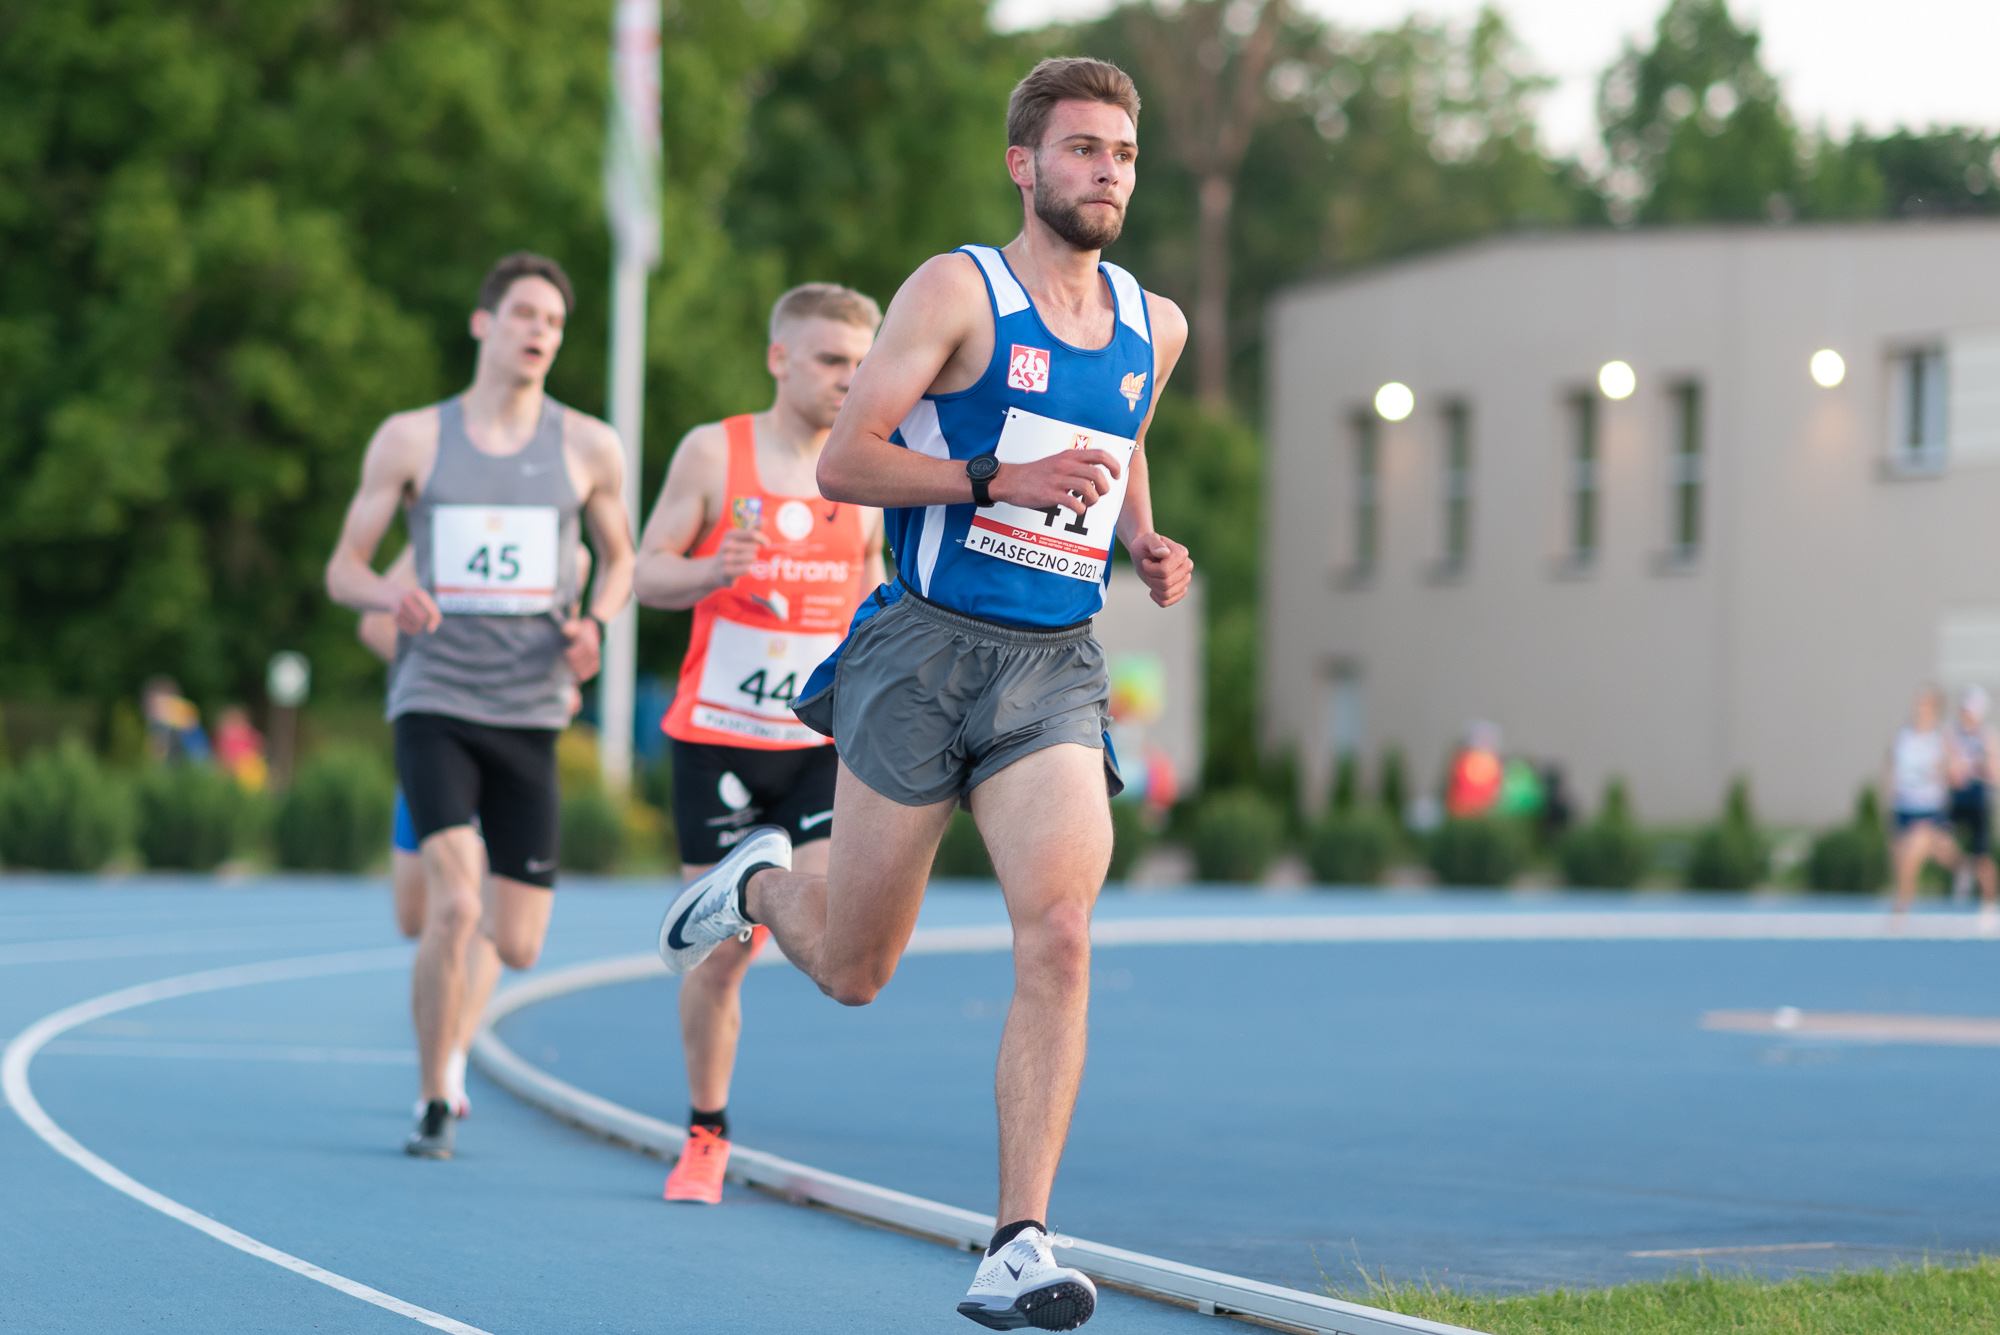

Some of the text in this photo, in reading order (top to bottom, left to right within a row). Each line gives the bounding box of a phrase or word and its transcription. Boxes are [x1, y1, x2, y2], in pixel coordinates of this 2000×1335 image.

[1012, 529, 1037, 542] PZLA
[467, 545, 520, 580] 45
[751, 554, 849, 582] eftrans
[979, 536, 1069, 572] PIASECZNO
[1072, 561, 1097, 579] 2021
[738, 668, 800, 709] 44
